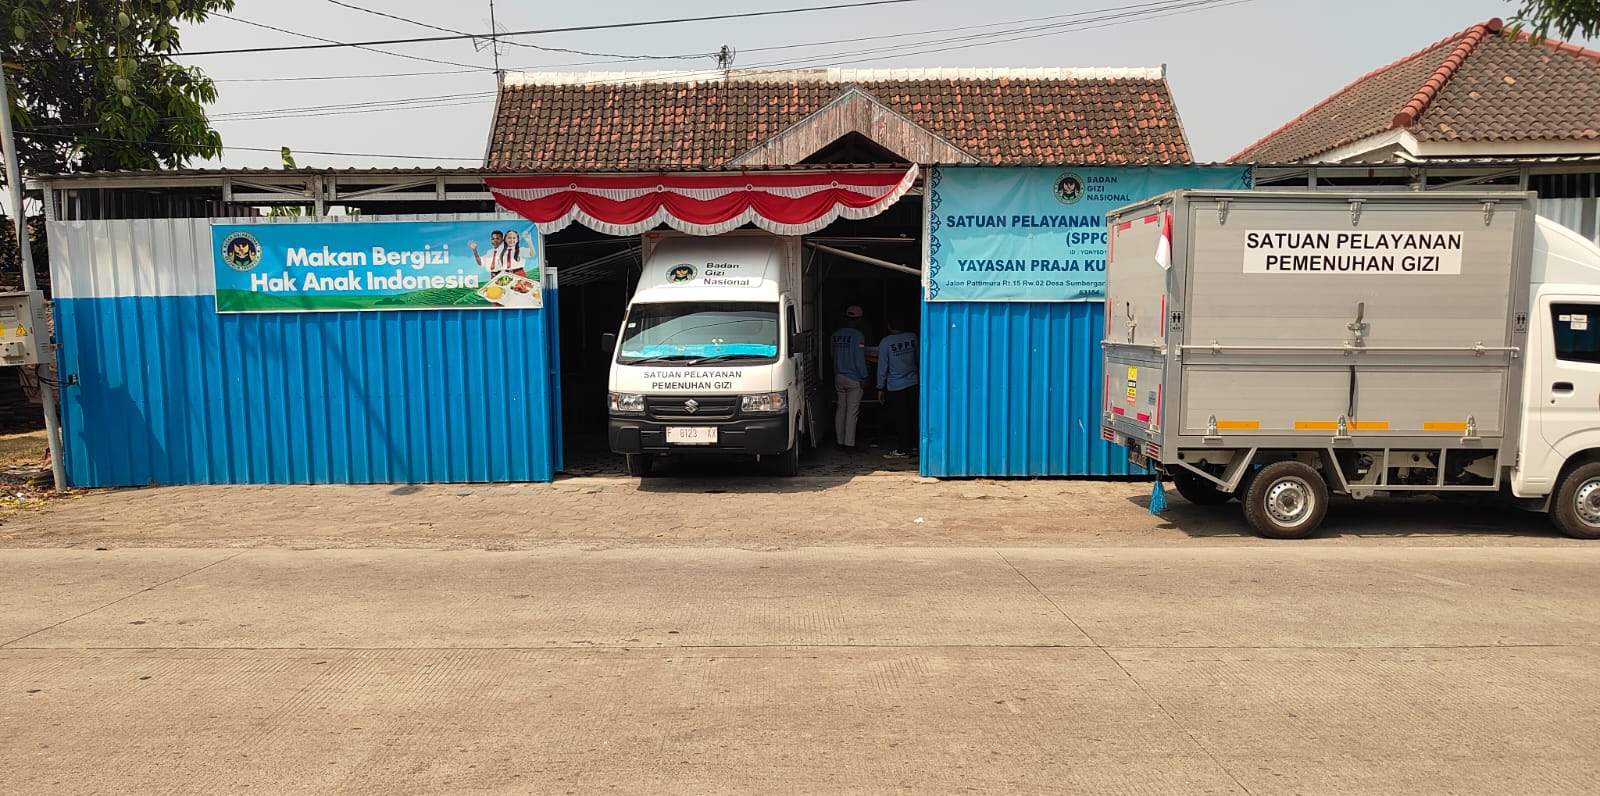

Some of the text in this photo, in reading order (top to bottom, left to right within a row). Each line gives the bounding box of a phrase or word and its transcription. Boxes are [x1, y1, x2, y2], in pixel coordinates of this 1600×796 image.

[946, 215, 1007, 228] SATUAN
[1012, 215, 1100, 228] PELAYANAN
[1246, 233, 1461, 250] SATUAN PELAYANAN
[286, 246, 367, 267] Makan
[372, 244, 450, 271] Bergizi
[1266, 255, 1440, 272] PEMENUHAN GIZI
[958, 259, 1026, 272] YAYASAN
[1030, 259, 1080, 272] PRAJA
[251, 269, 479, 293] Hak Anak Indonesia
[703, 278, 750, 286] Nasional
[643, 370, 742, 379] SATUAN PELAYANAN
[652, 381, 732, 390] PEMENUHAN GIZI
[679, 428, 698, 438] 8123
